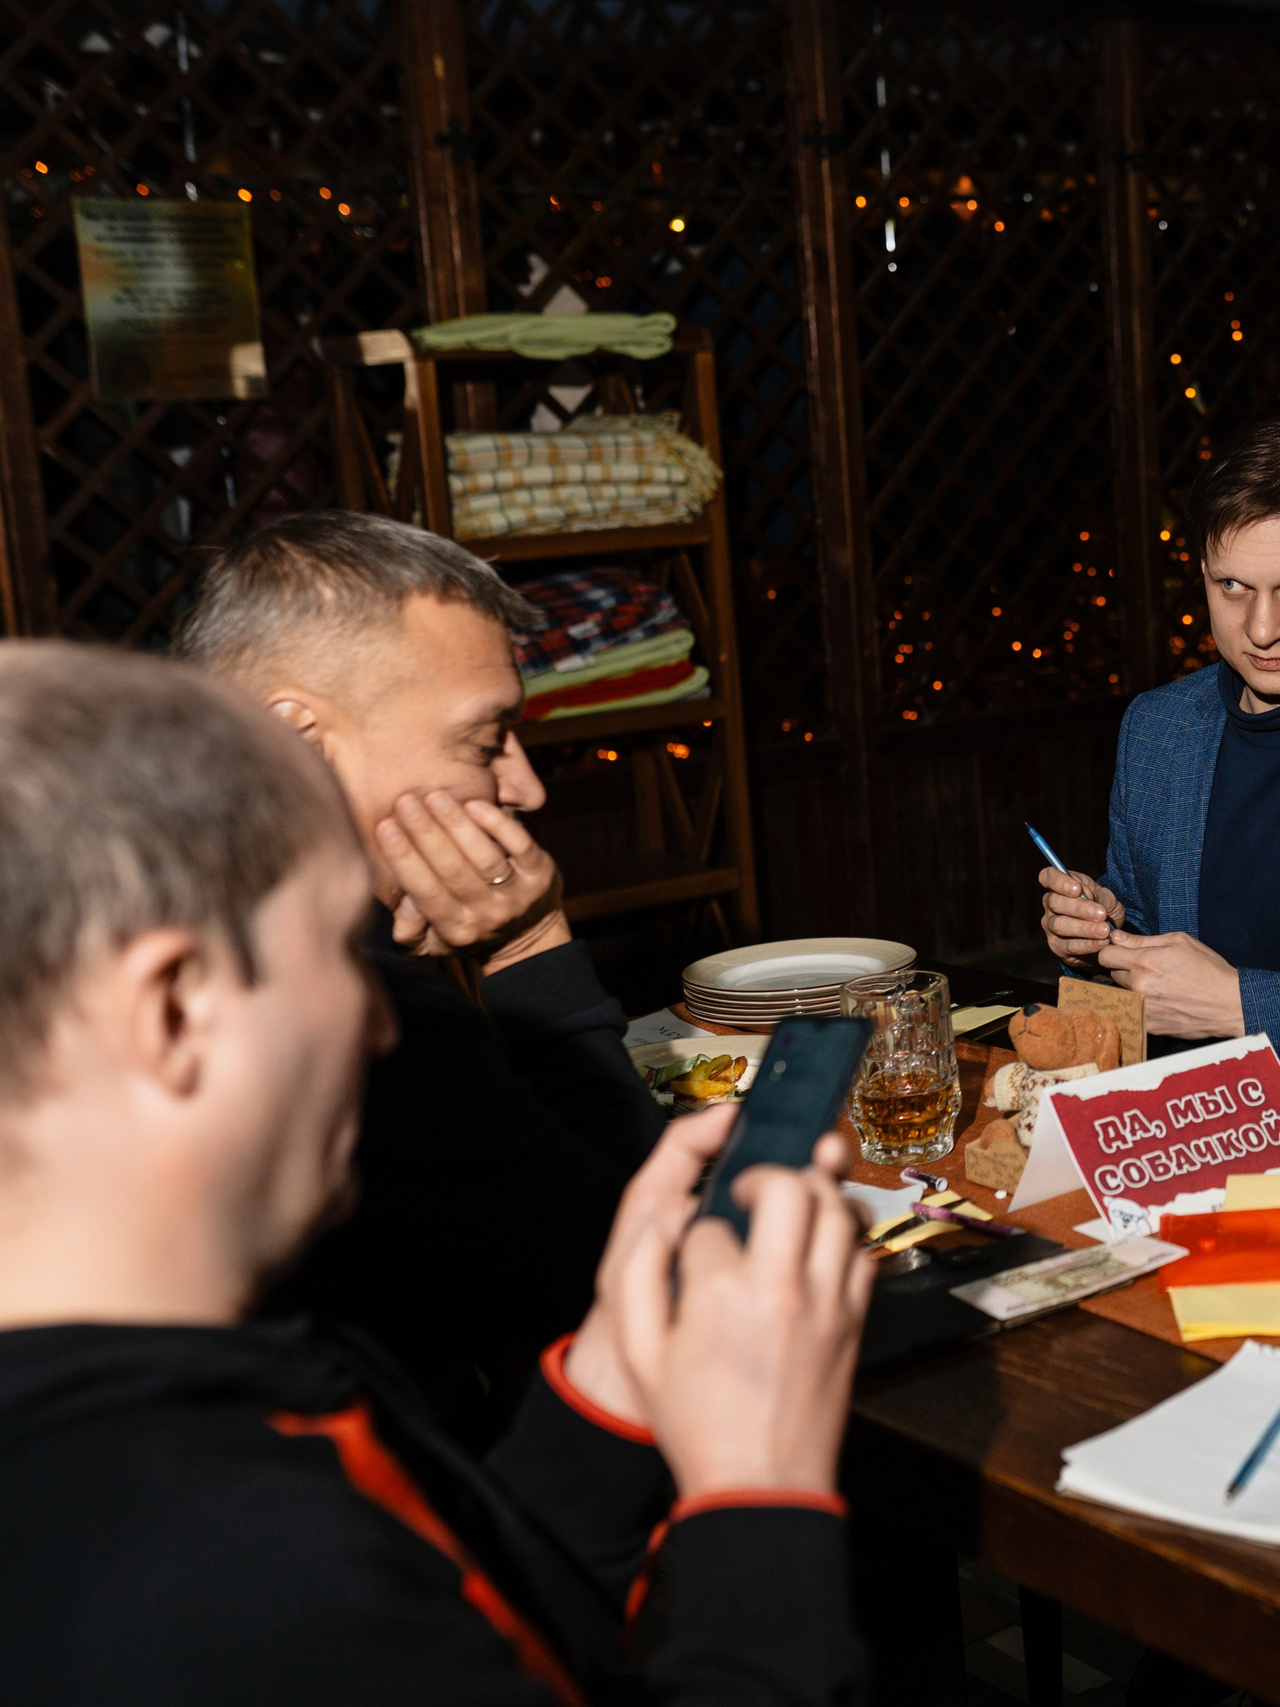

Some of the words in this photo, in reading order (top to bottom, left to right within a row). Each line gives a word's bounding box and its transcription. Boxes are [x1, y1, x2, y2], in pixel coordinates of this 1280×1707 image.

[1093, 1109, 1167, 1153] ДА,
[1166, 1085, 1237, 1128] МЫ
[1237, 1078, 1266, 1106] С
